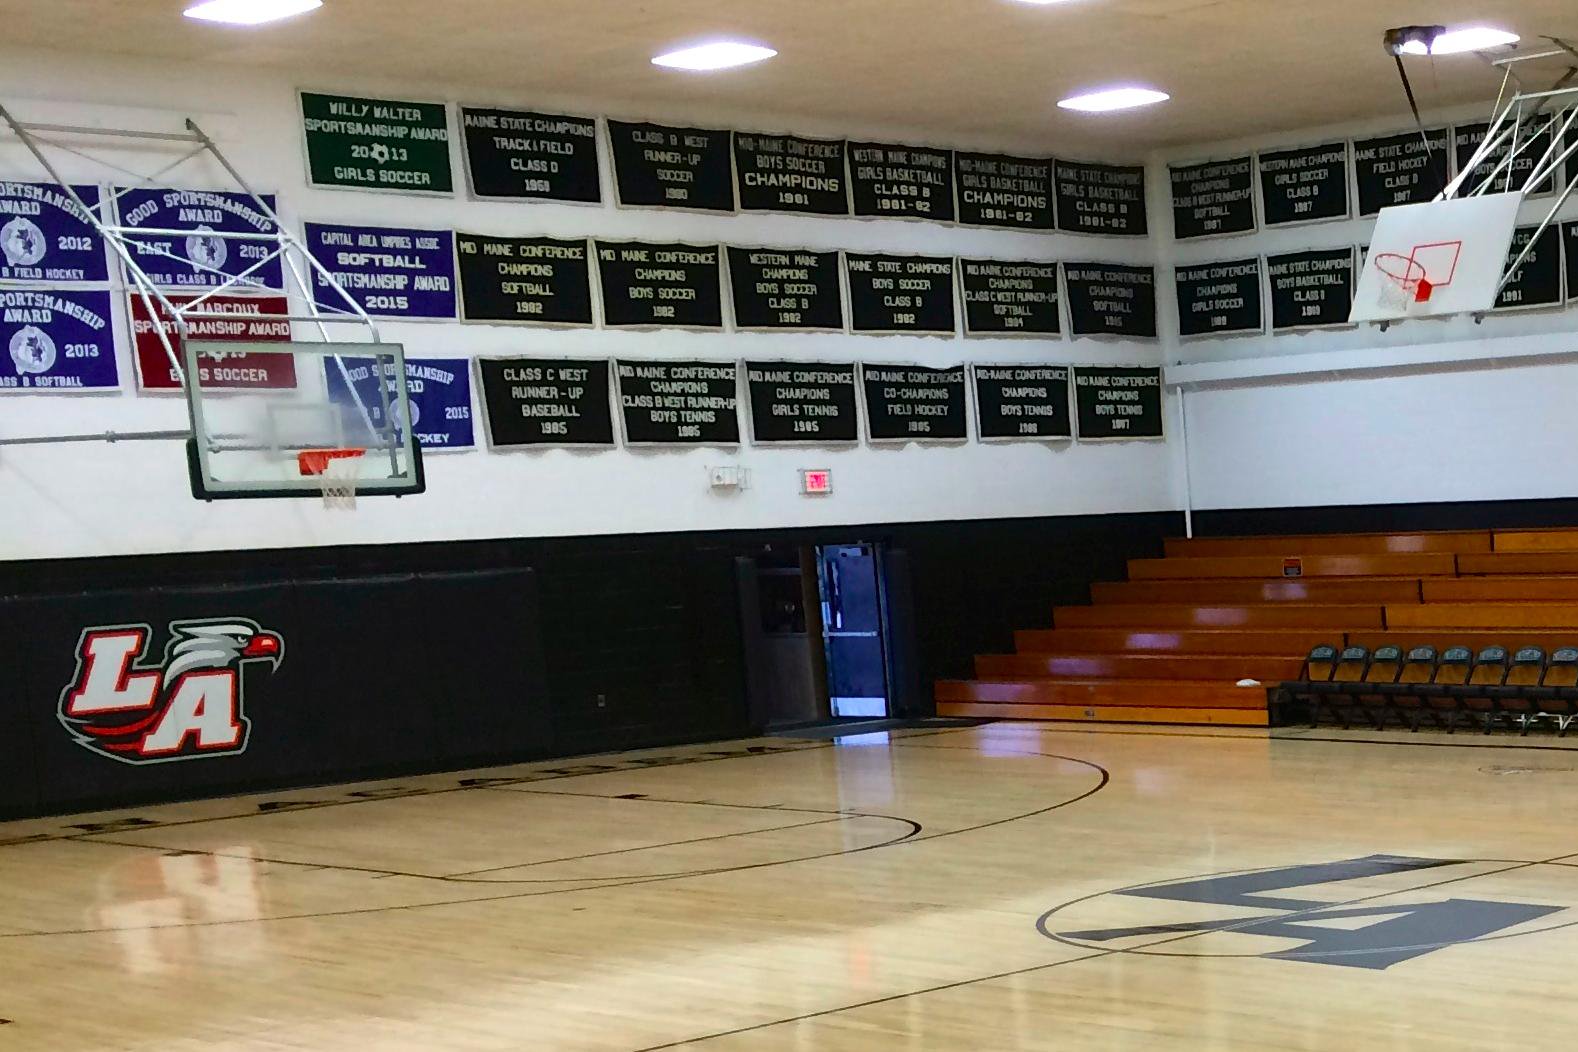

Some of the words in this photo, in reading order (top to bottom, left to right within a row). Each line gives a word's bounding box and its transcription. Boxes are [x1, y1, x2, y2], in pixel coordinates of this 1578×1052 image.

[330, 102, 369, 116] WILLY
[373, 105, 421, 121] WALTER
[305, 118, 408, 138] SPORTSMANSHIP
[410, 127, 447, 140] AWARD
[500, 118, 533, 131] STATE
[535, 120, 594, 137] CHAMPIONS
[540, 141, 573, 155] FIELD
[511, 158, 547, 172] CLASS
[757, 155, 784, 169] BOYS
[786, 157, 825, 173] SOCCER
[334, 167, 375, 181] GIRLS
[379, 170, 431, 184] SOCCER
[745, 173, 839, 192] CHAMPIONS
[874, 184, 917, 195] CLASS
[964, 191, 1046, 208] CHAMPIONS
[126, 200, 158, 226] GOOD
[163, 192, 271, 232] SPORTSMANSHIP
[179, 209, 222, 222] AWARD
[58, 236, 92, 250] 2012
[322, 232, 354, 246] CAPITAL
[240, 245, 268, 258] 2013
[520, 245, 583, 260] CONFERENCE
[656, 251, 715, 264] CONFERENCE
[337, 252, 426, 268] SOFTBALL
[14, 267, 42, 278] FIELD
[46, 268, 84, 279] HOCKEY
[498, 262, 553, 276] CHAMPIONS
[878, 262, 902, 273] STATE
[908, 262, 950, 274] CHAMPIONS
[177, 274, 205, 284] CLASS
[636, 268, 685, 282] CHAMPIONS
[414, 276, 449, 291] AWARD
[502, 282, 553, 296] SOFTBALL
[873, 278, 893, 290] BOYS
[899, 279, 930, 290] SOCCER
[629, 287, 653, 299] BOYS
[659, 288, 695, 300] SOCCER
[365, 296, 408, 309] 2015
[885, 296, 910, 307] CLASS
[4, 309, 52, 323] AWARD
[249, 323, 290, 335] AWARD
[64, 344, 99, 357] 2013
[35, 376, 83, 386] SOFTBALL
[214, 368, 267, 381] SOCCER
[504, 369, 542, 381] CLASS
[547, 369, 555, 381] C
[559, 369, 588, 381] WEST
[776, 388, 829, 399] CHAMPIONS
[445, 407, 469, 419] 2015
[522, 405, 580, 417] BASEBALL
[772, 405, 799, 416] GIRLS
[803, 405, 838, 416] TENNIS
